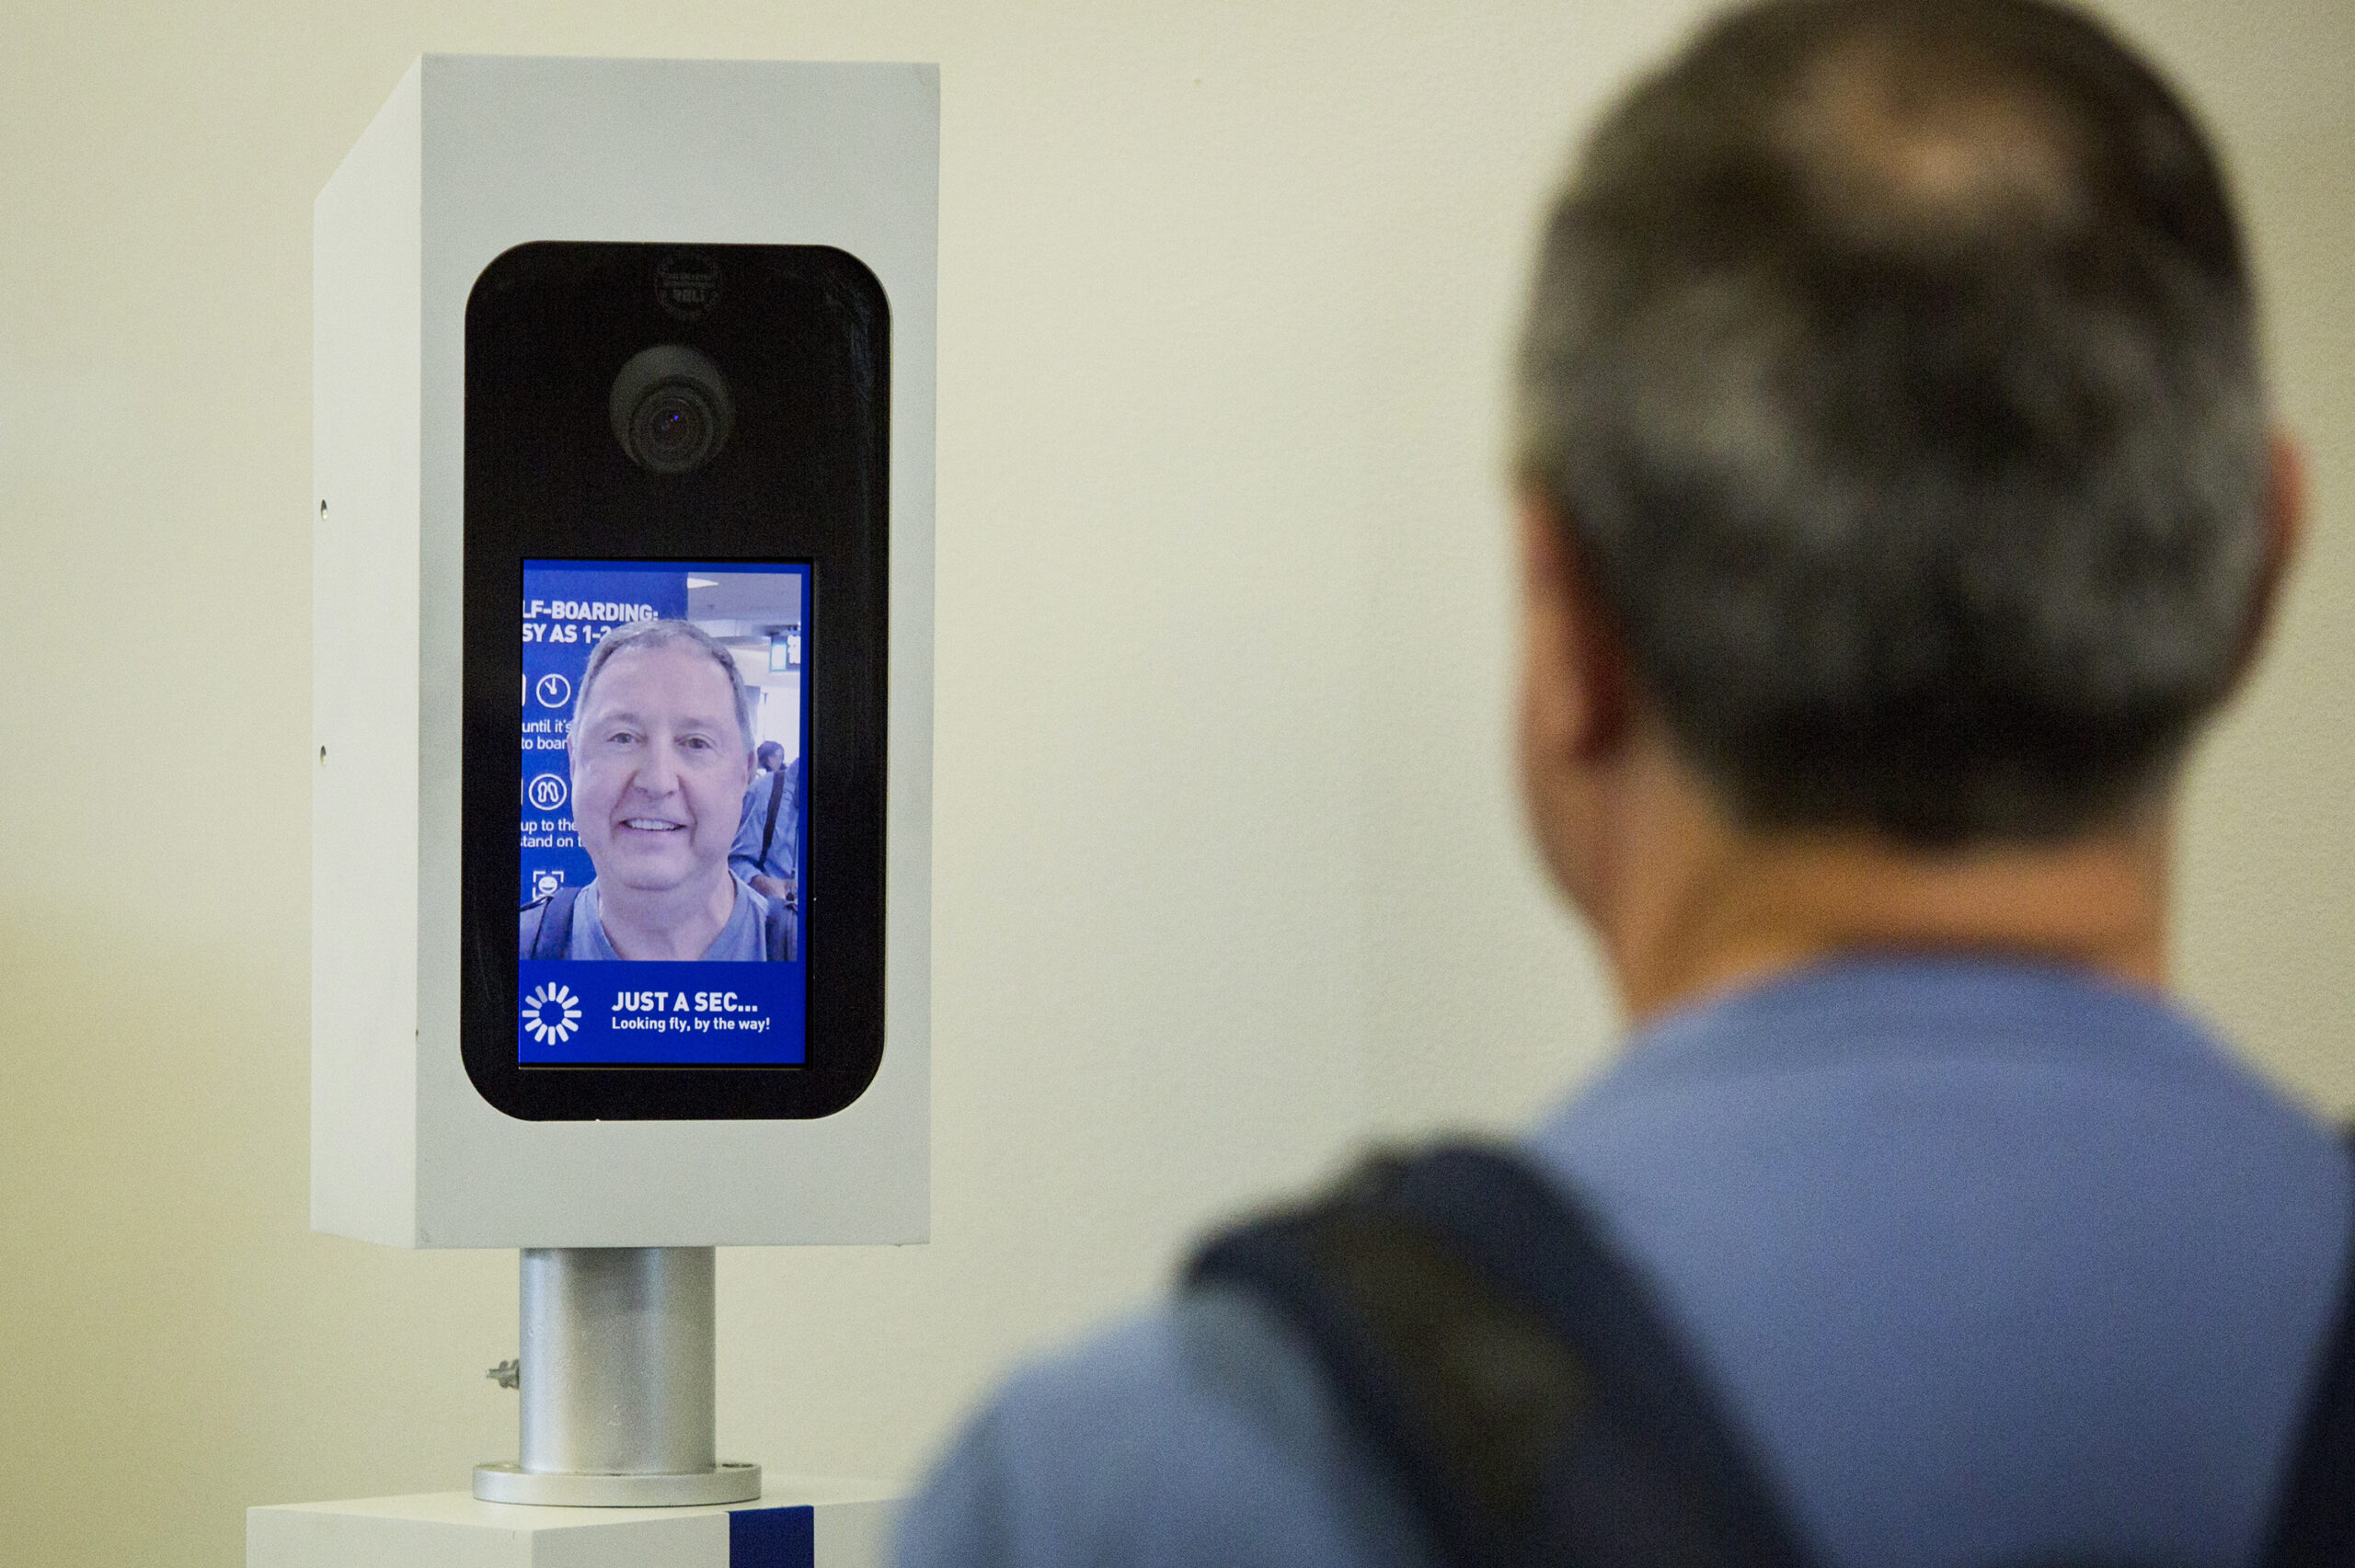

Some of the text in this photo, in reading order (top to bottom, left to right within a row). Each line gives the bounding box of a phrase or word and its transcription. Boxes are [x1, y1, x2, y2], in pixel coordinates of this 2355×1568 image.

[523, 600, 659, 622] LF-BOARDING:
[523, 623, 547, 643] SY
[549, 624, 578, 644] AS
[522, 718, 571, 733] until it's
[522, 737, 534, 750] to
[521, 820, 538, 835] up
[541, 818, 555, 831] to
[557, 837, 574, 847] on
[612, 991, 758, 1013] JUST A SEC...
[612, 1016, 770, 1034] Looking fly, by the way!
